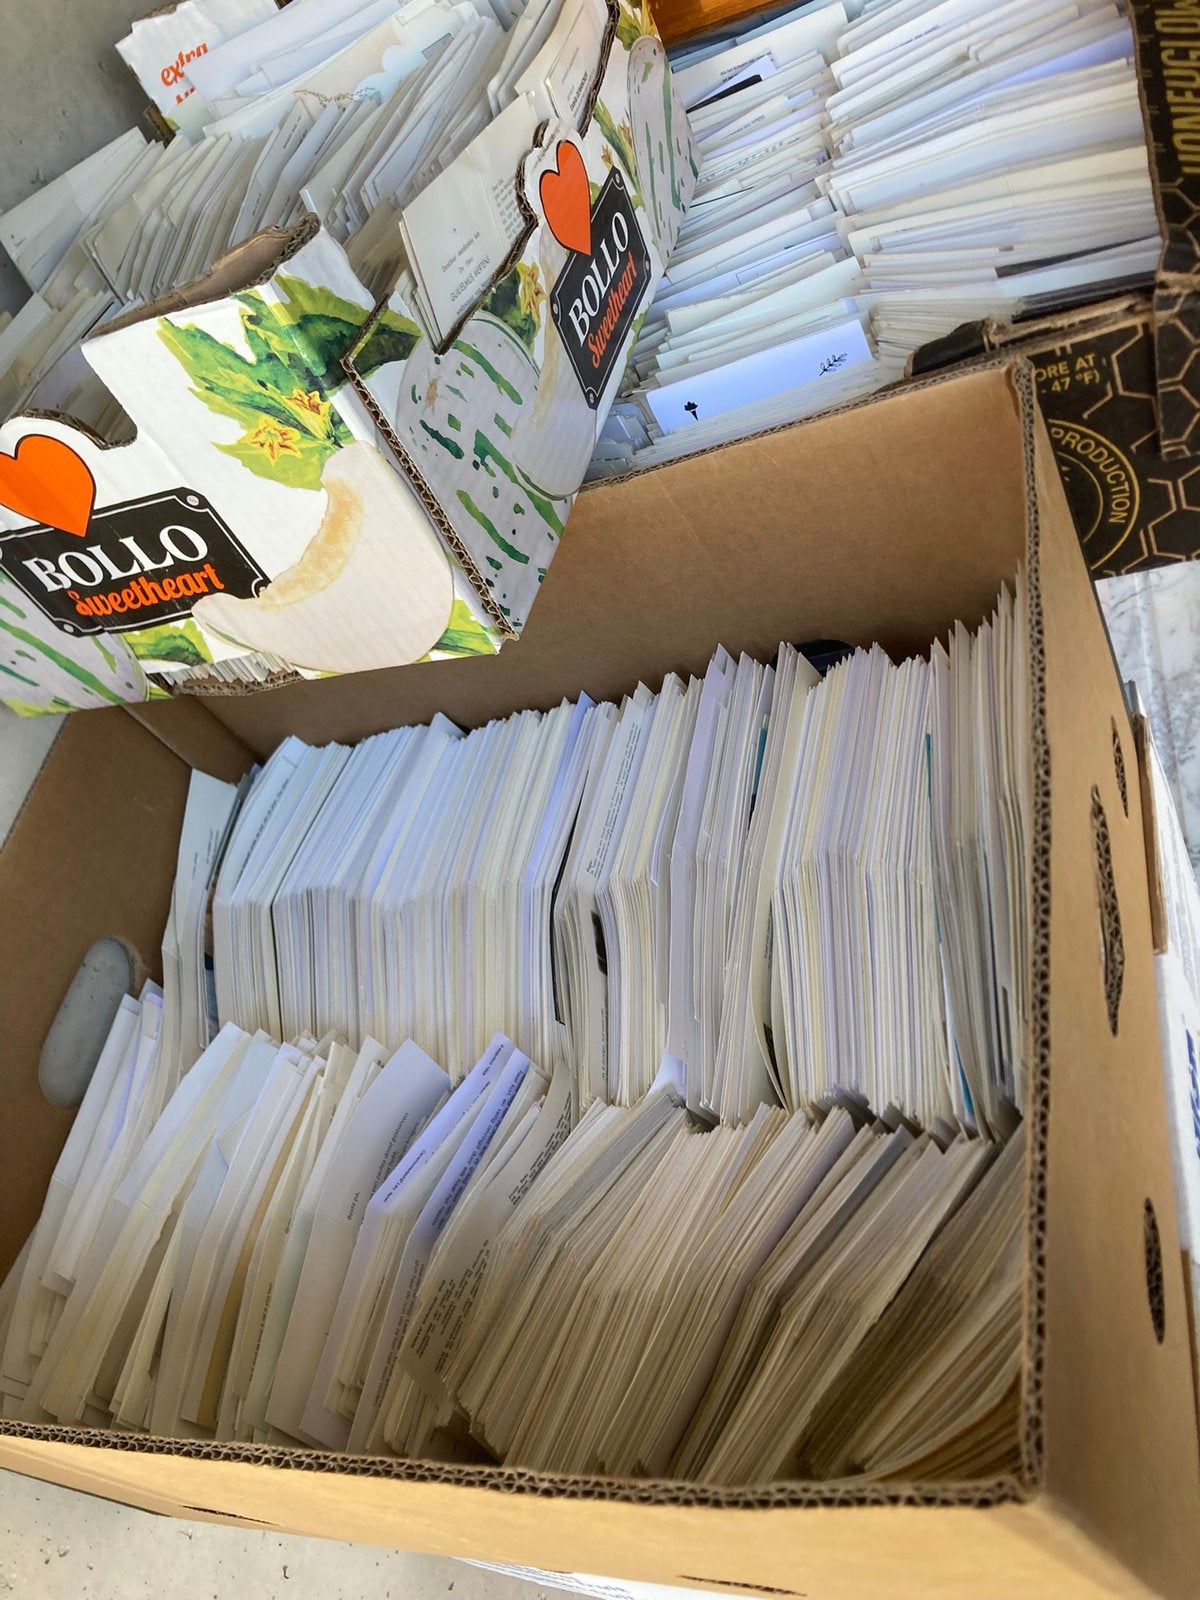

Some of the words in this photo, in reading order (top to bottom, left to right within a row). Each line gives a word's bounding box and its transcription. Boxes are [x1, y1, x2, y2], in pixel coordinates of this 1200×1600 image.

[568, 211, 629, 348] BOLLO
[587, 250, 638, 369] Sweetheart
[1034, 361, 1070, 382] ORE
[1075, 353, 1096, 371] AT
[1051, 377, 1071, 393] 47
[1051, 427, 1131, 523] PRODUCTION
[22, 524, 208, 592] BOLLO
[68, 562, 225, 617] Sweetheart
